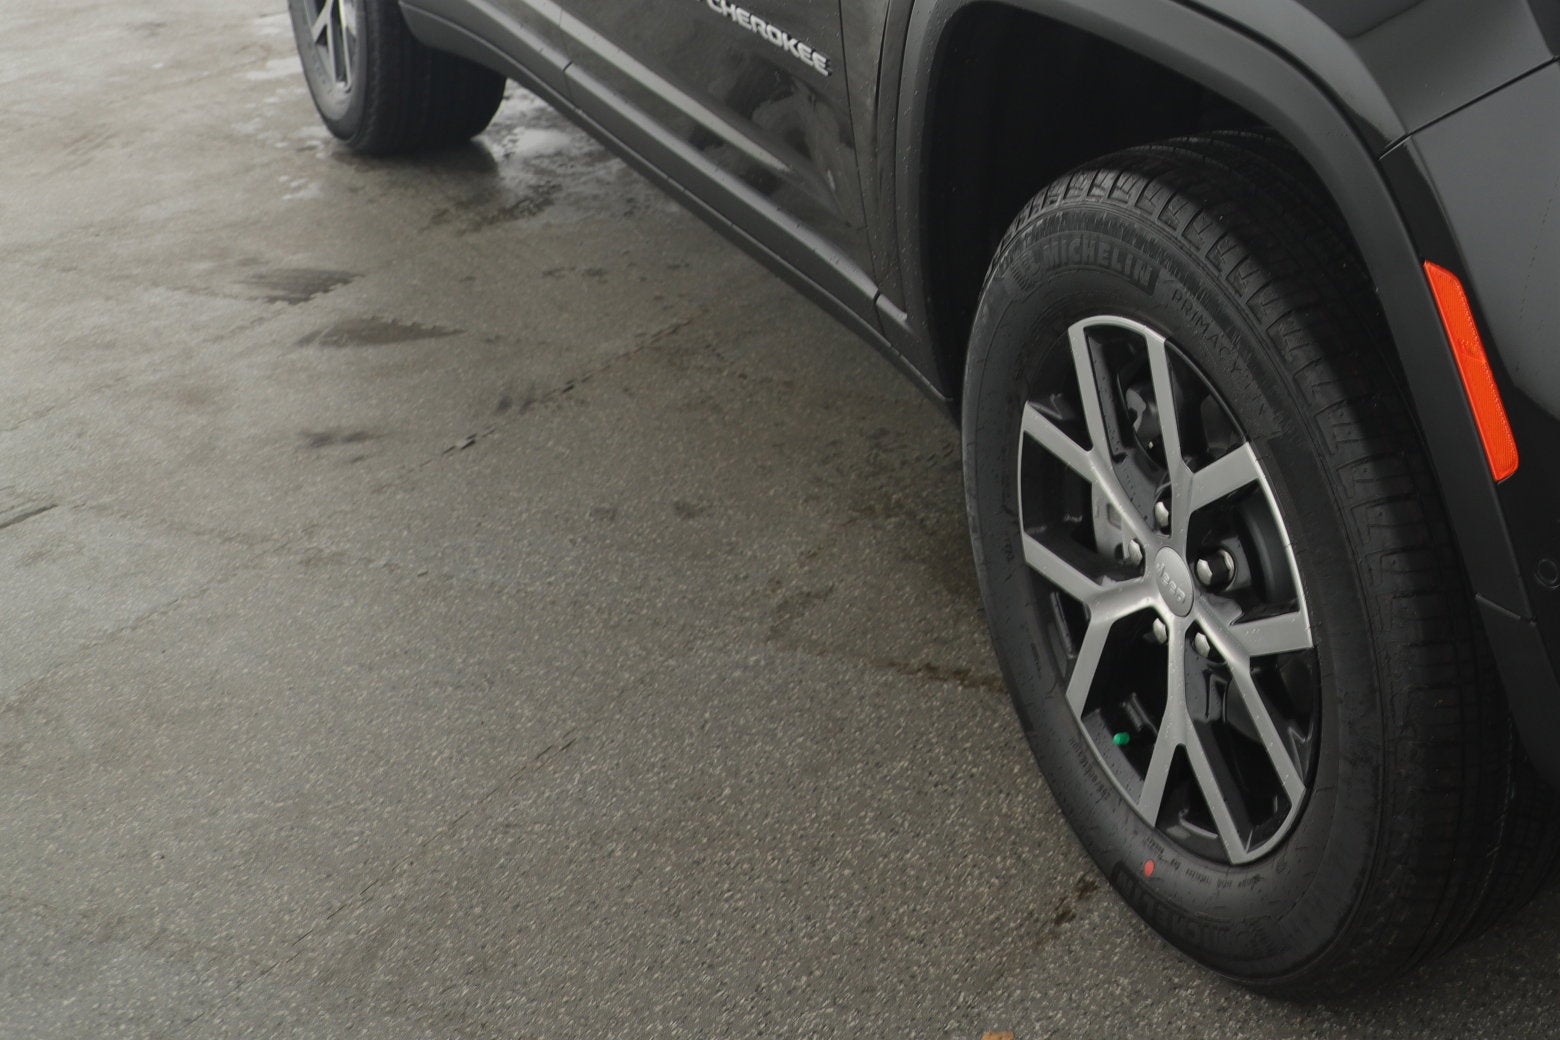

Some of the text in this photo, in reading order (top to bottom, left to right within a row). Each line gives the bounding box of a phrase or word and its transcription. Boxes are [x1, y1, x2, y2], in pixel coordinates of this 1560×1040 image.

[1042, 236, 1153, 288] MICHELIN
[1171, 289, 1242, 374] PRIMACY
[1156, 562, 1186, 604] Jeep
